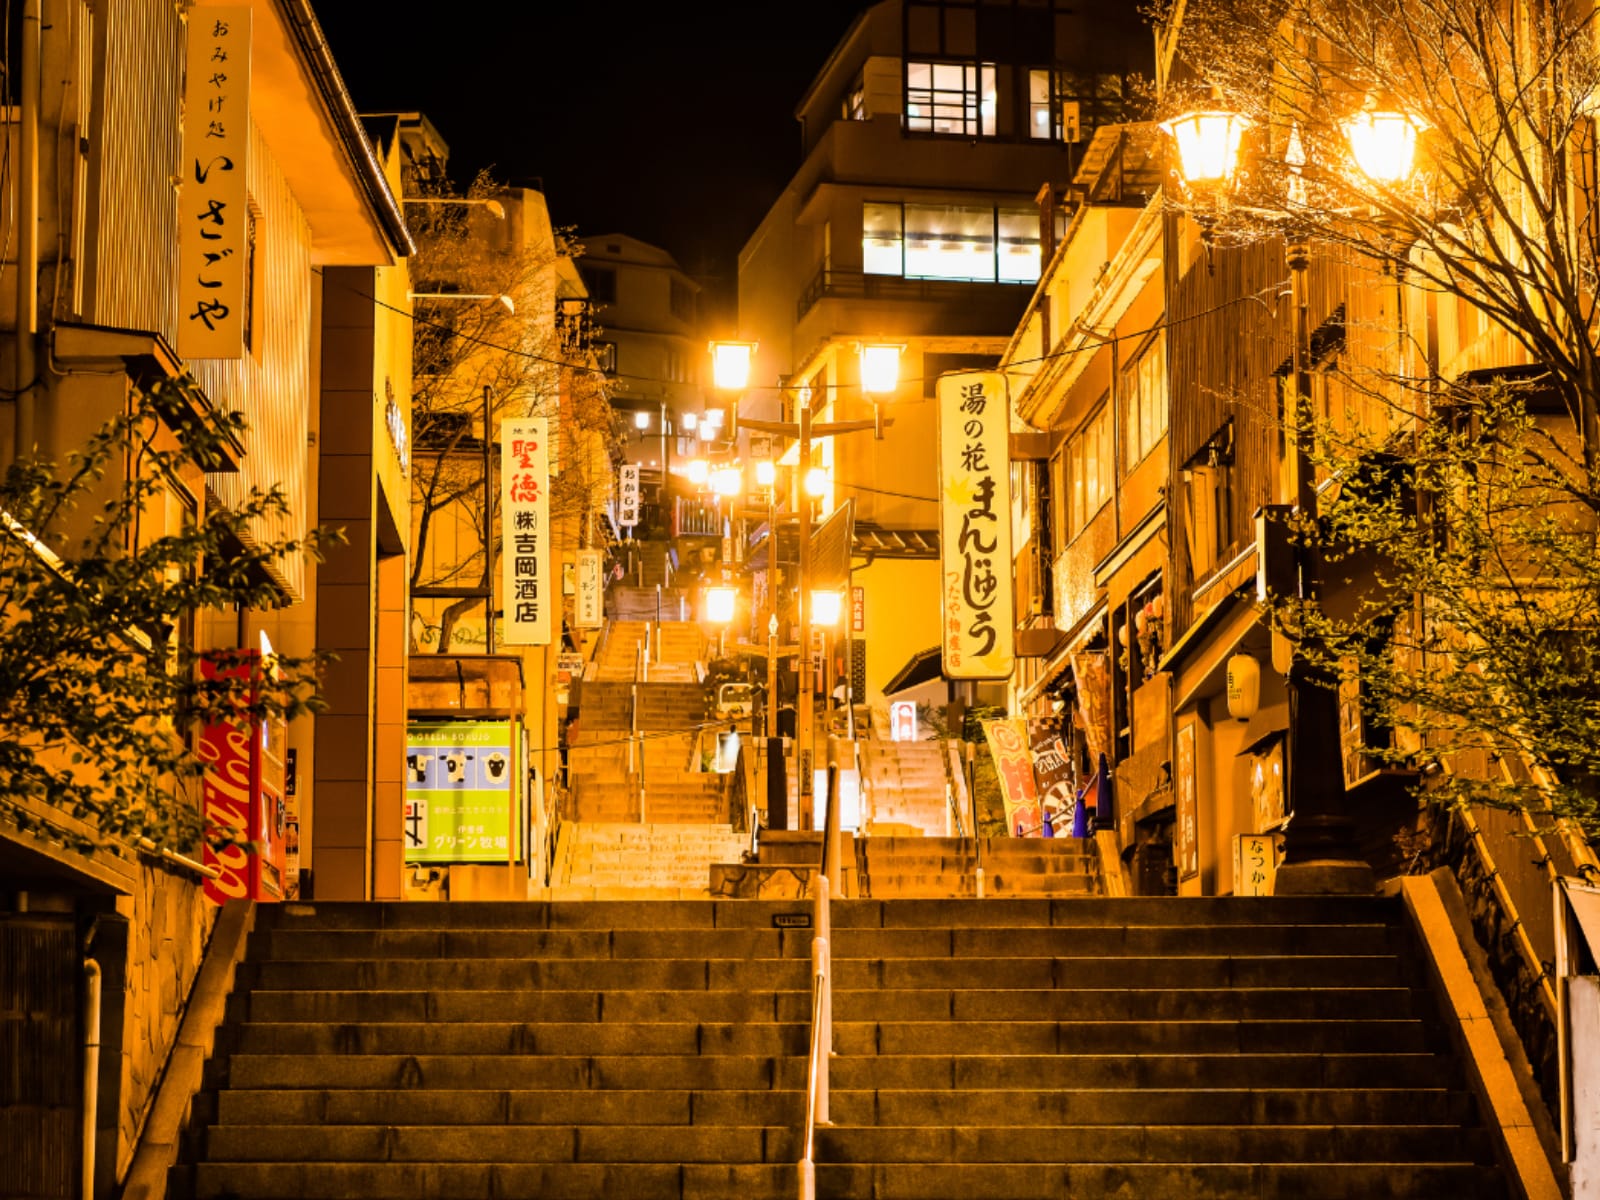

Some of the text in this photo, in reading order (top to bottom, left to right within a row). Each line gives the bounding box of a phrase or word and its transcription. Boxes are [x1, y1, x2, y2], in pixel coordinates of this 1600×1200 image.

[190, 20, 234, 331] おみやげ処 いさごや
[510, 440, 542, 503] 聖徳
[434, 835, 507, 849] グリーン牧場
